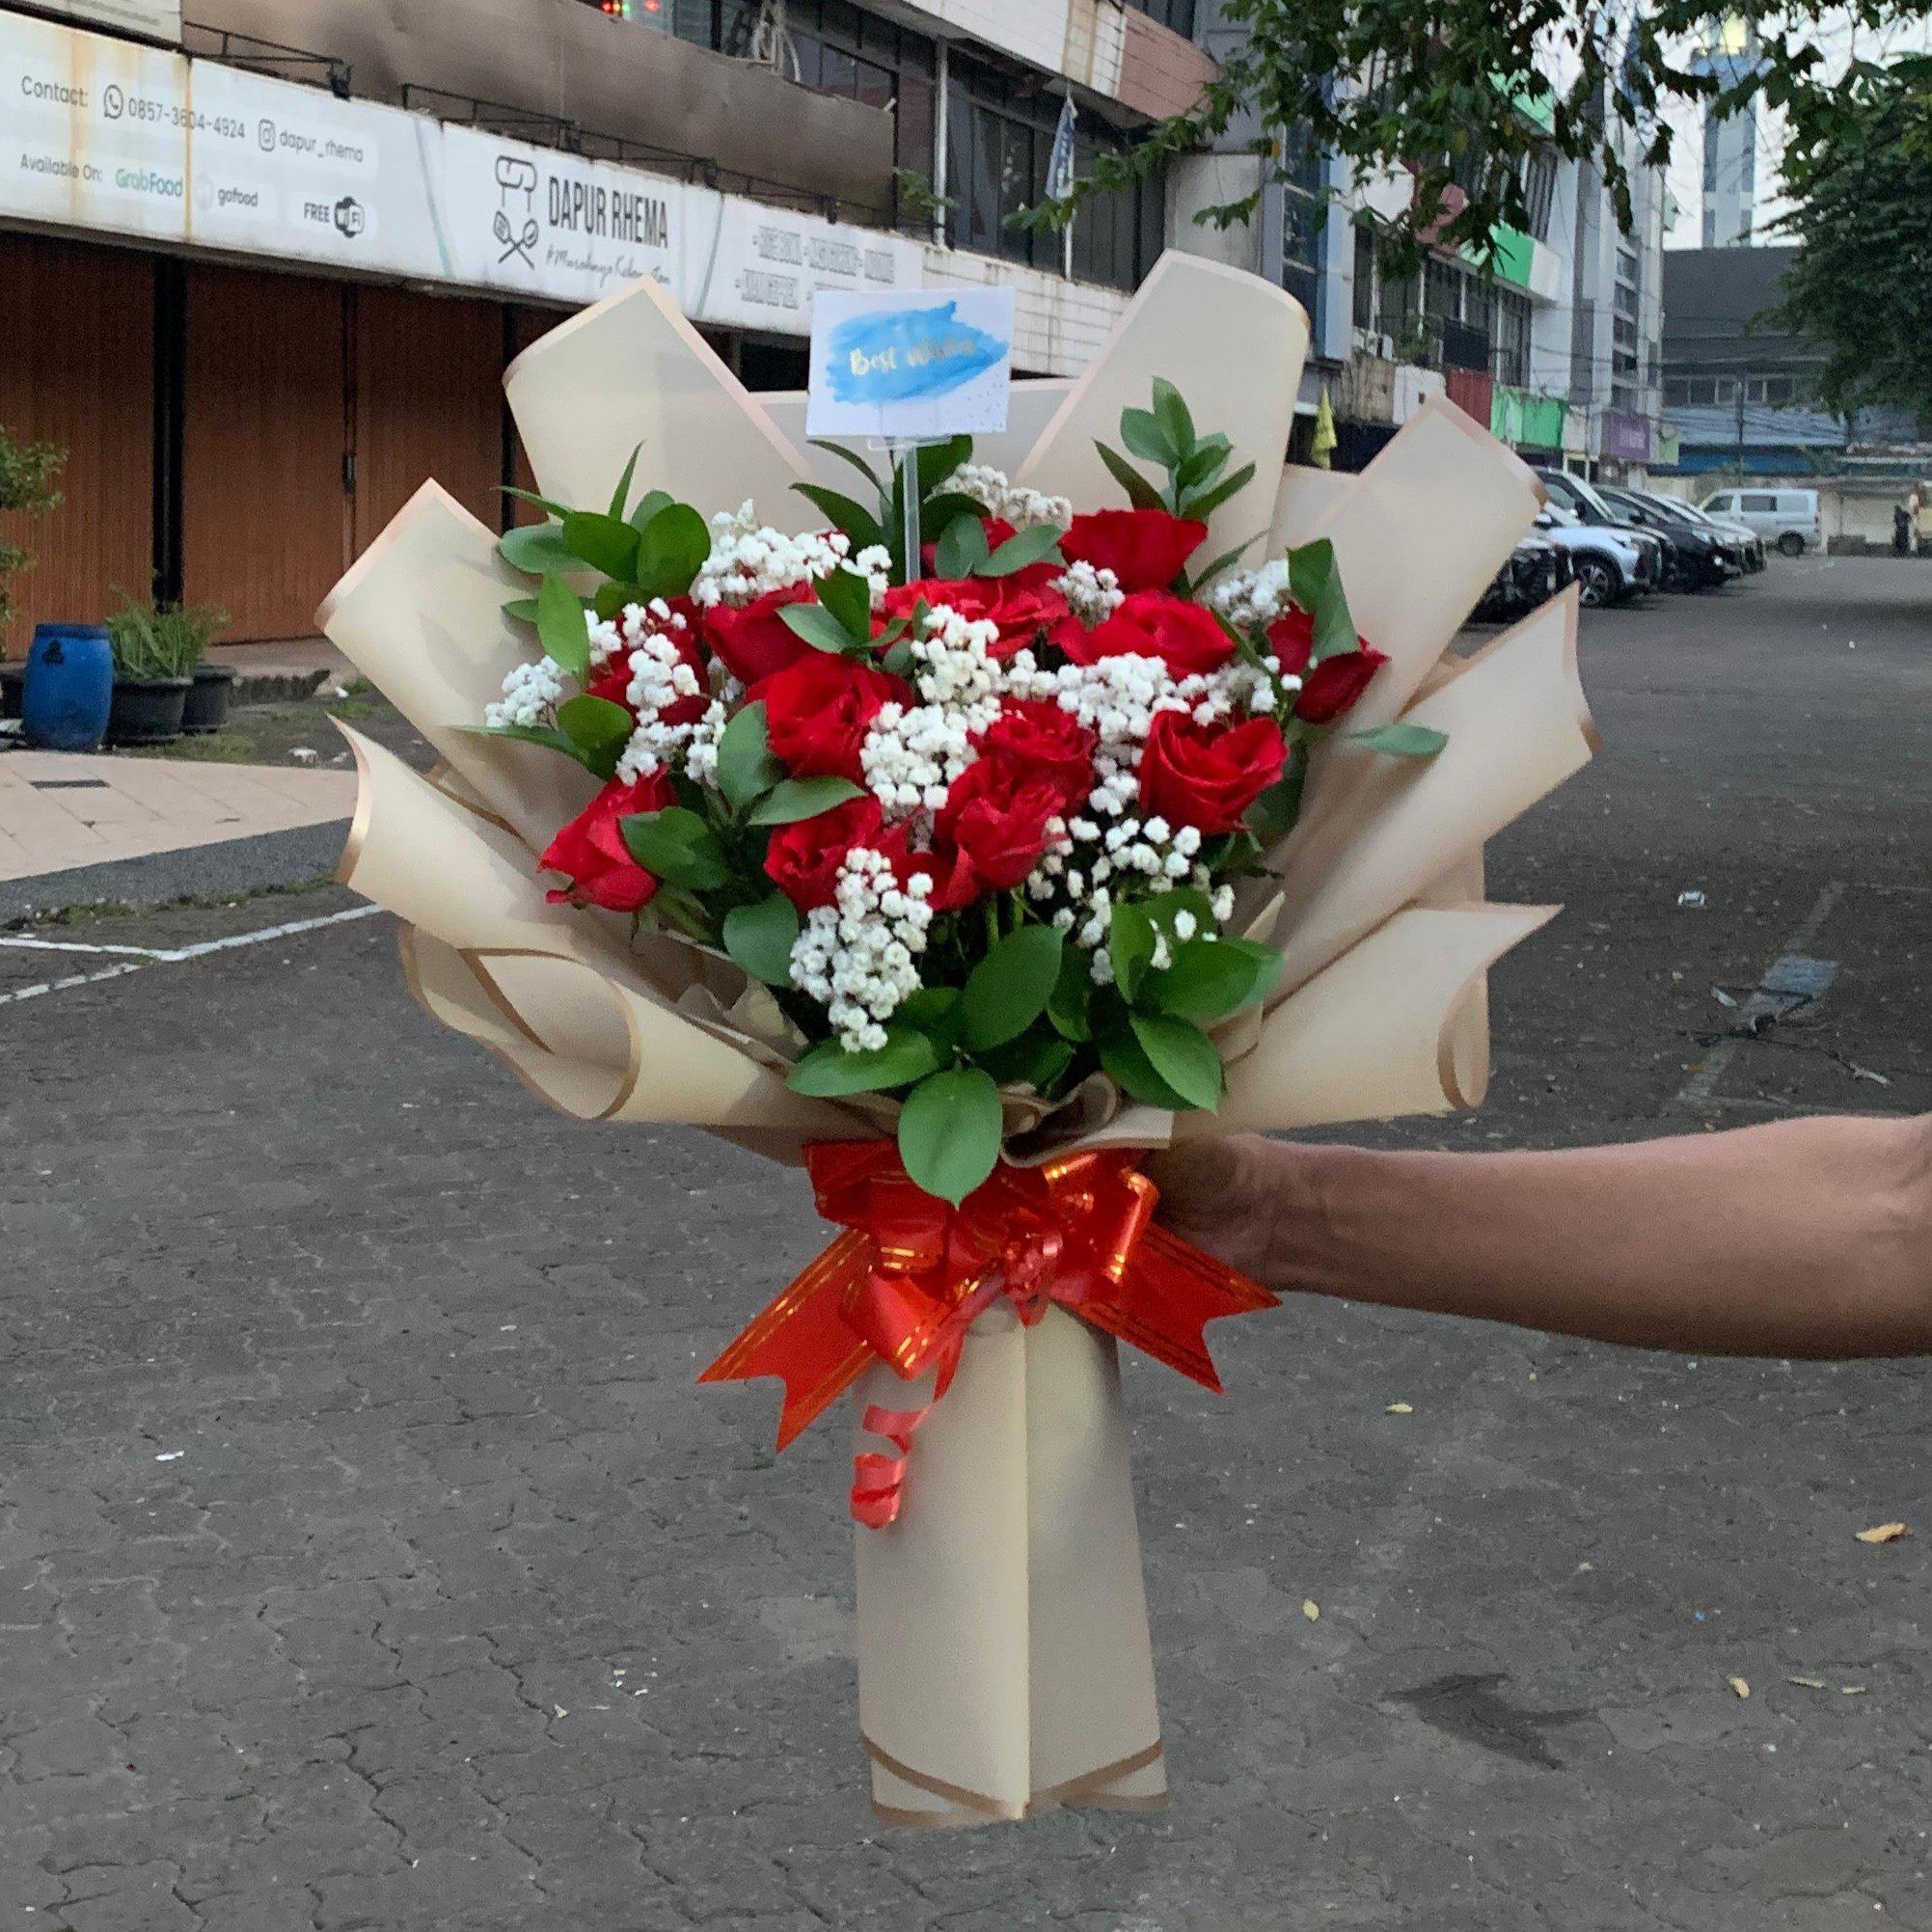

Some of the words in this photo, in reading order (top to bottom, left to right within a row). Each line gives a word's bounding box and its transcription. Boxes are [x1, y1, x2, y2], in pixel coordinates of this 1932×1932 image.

[19, 153, 80, 178] Available
[115, 167, 183, 197] GrabFood
[217, 187, 259, 207] gofood
[304, 203, 331, 223] FREE
[549, 176, 606, 237] DAPUR
[612, 189, 667, 249] RHEMA
